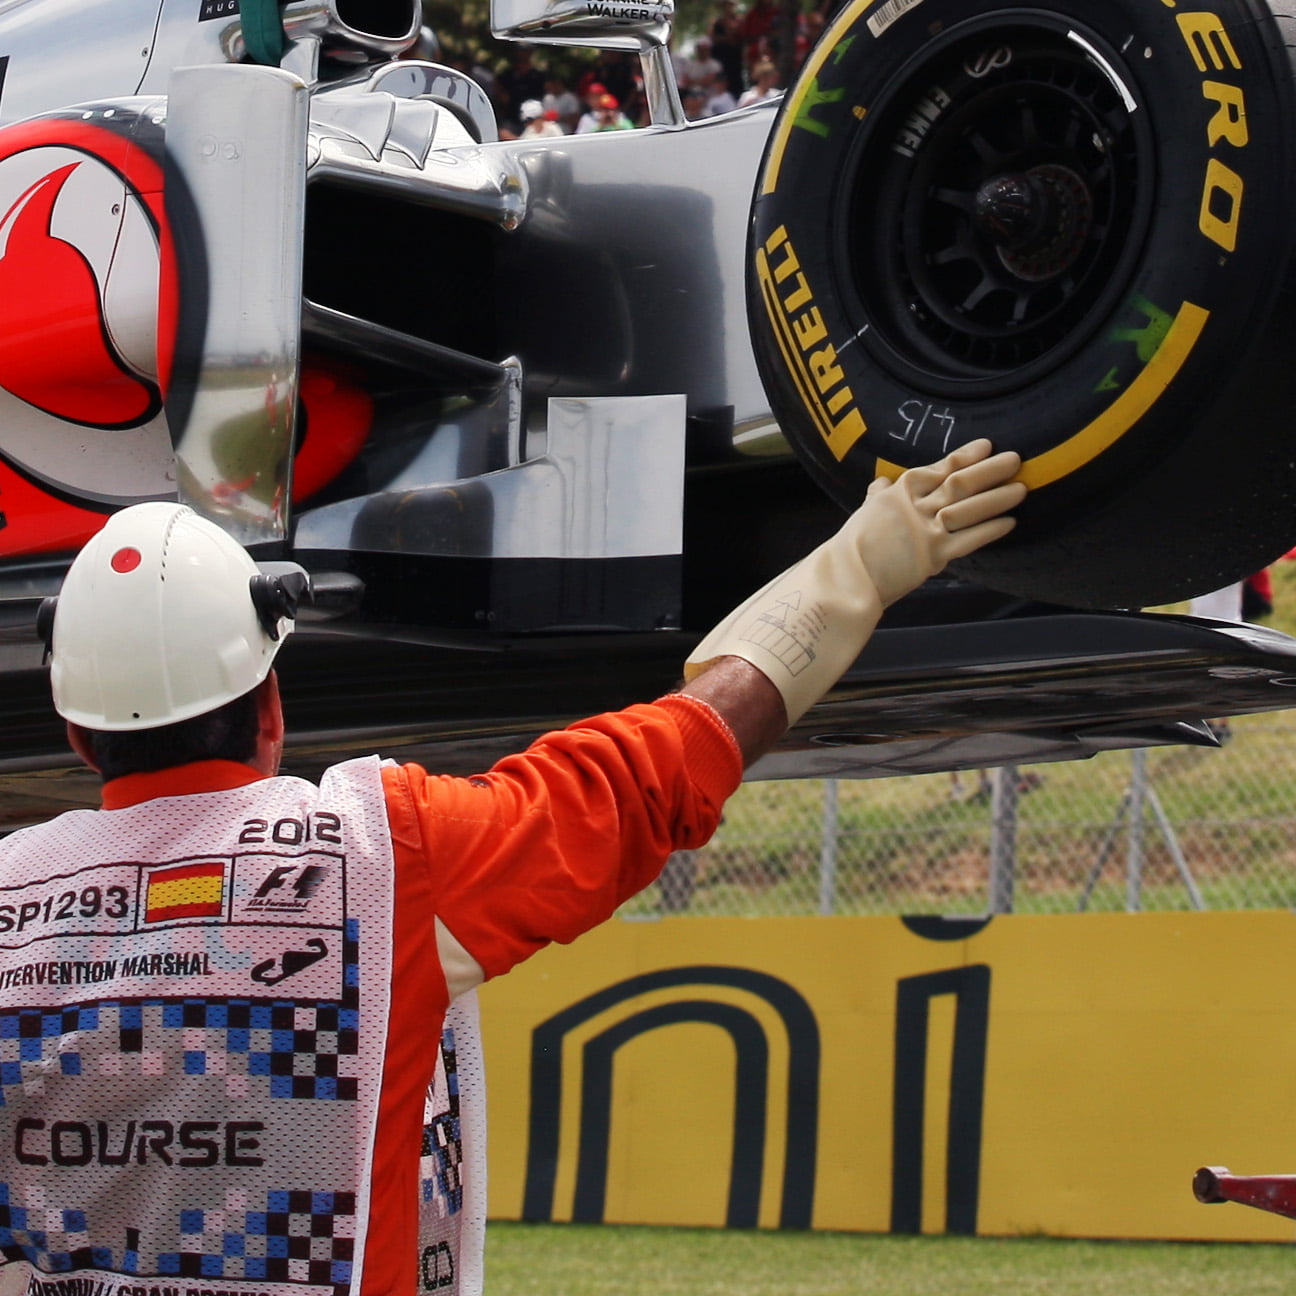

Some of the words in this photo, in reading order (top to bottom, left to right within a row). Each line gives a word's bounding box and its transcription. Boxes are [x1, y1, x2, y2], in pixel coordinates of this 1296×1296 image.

[587, 3, 649, 20] WALKER
[755, 224, 866, 462] PIRELLI
[239, 811, 342, 845] 2012
[122, 952, 213, 979] MARSHAL
[522, 914, 994, 1235] ni
[14, 1119, 266, 1169] COURSE
